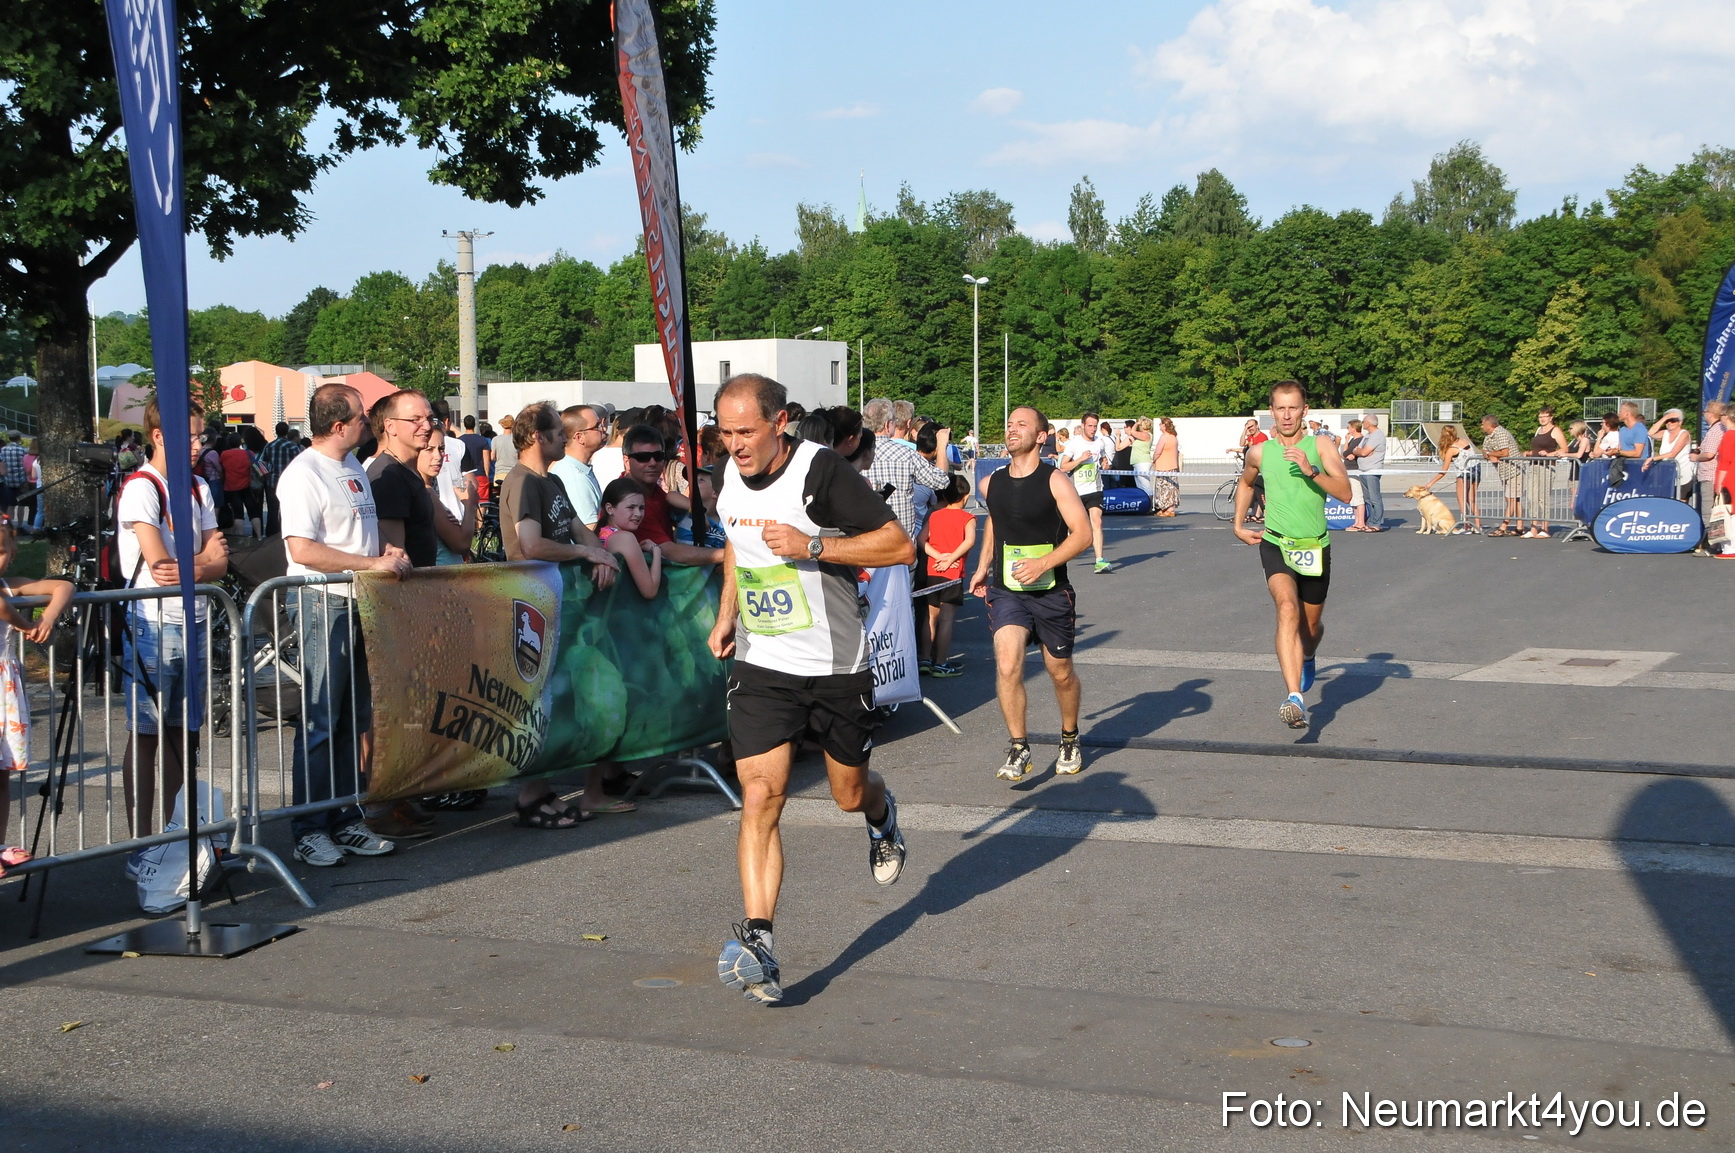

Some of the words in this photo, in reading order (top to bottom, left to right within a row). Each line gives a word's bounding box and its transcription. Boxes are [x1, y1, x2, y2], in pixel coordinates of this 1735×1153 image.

[1078, 469, 1093, 478] 510
[1602, 486, 1655, 505] Fisch
[1620, 521, 1690, 535] Fischer
[1626, 534, 1685, 542] AUTOMOBILE
[746, 589, 794, 618] 549
